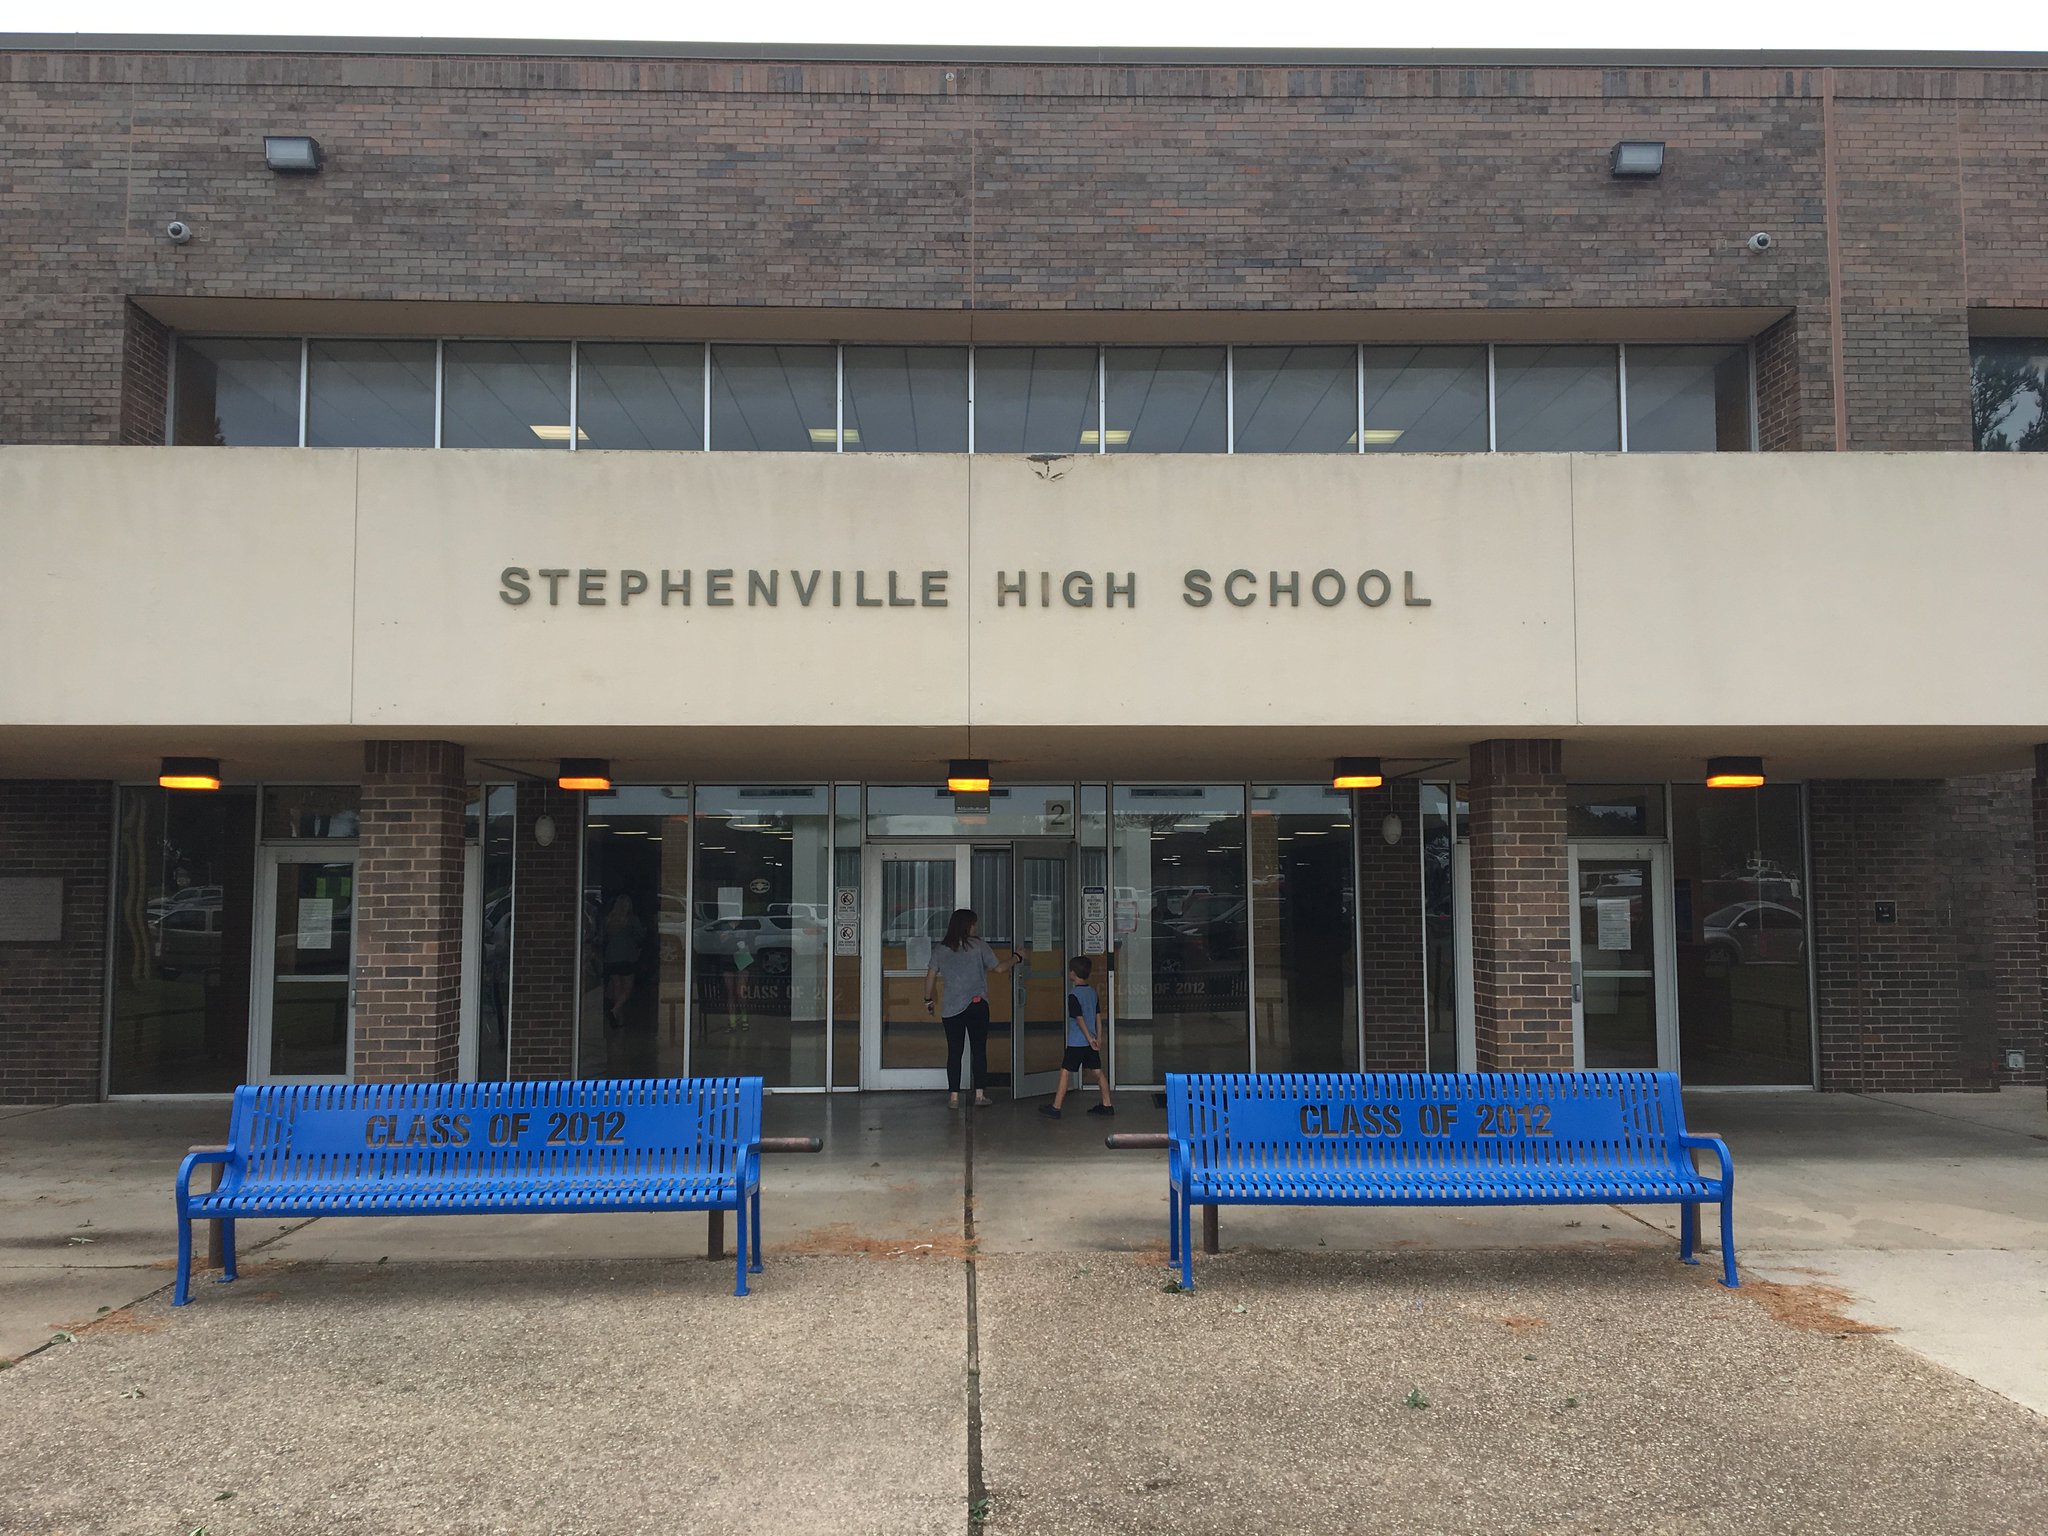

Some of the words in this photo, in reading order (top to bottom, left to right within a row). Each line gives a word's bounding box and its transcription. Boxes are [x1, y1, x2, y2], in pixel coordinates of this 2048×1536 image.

[498, 566, 949, 607] STEPHENVILLE
[997, 570, 1136, 608] HIGH
[1183, 568, 1432, 608] SCHOOL
[1050, 803, 1065, 826] 2
[1175, 982, 1206, 995] 2012
[365, 1113, 471, 1149] CLASS
[487, 1112, 531, 1148] OF
[546, 1111, 626, 1147] 2012
[1299, 1103, 1403, 1139] CLASS
[1418, 1103, 1459, 1138] OF
[1475, 1103, 1554, 1138] 2012
